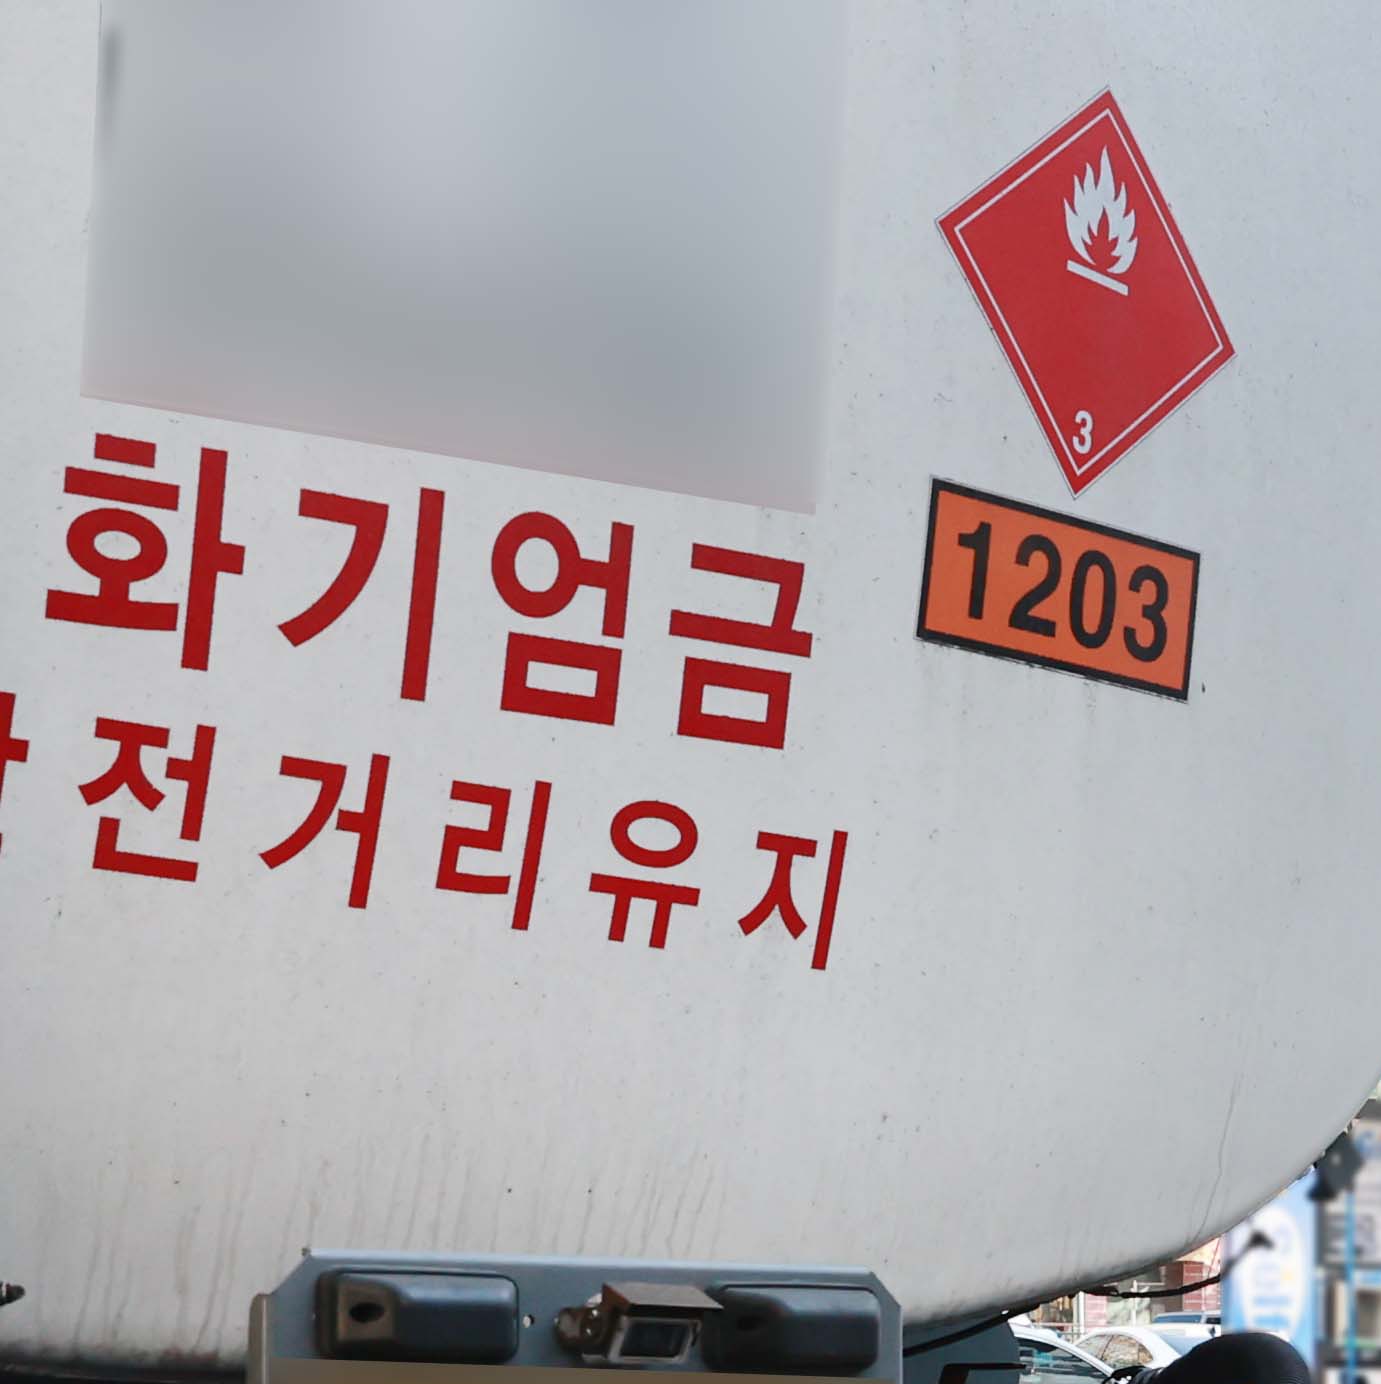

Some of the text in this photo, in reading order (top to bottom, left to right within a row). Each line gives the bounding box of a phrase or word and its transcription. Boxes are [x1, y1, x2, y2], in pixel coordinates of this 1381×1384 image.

[1072, 411, 1094, 455] 3
[45, 433, 814, 749] 화기엄금
[956, 520, 1171, 664] 1203
[0, 690, 849, 970] 전거리유지
